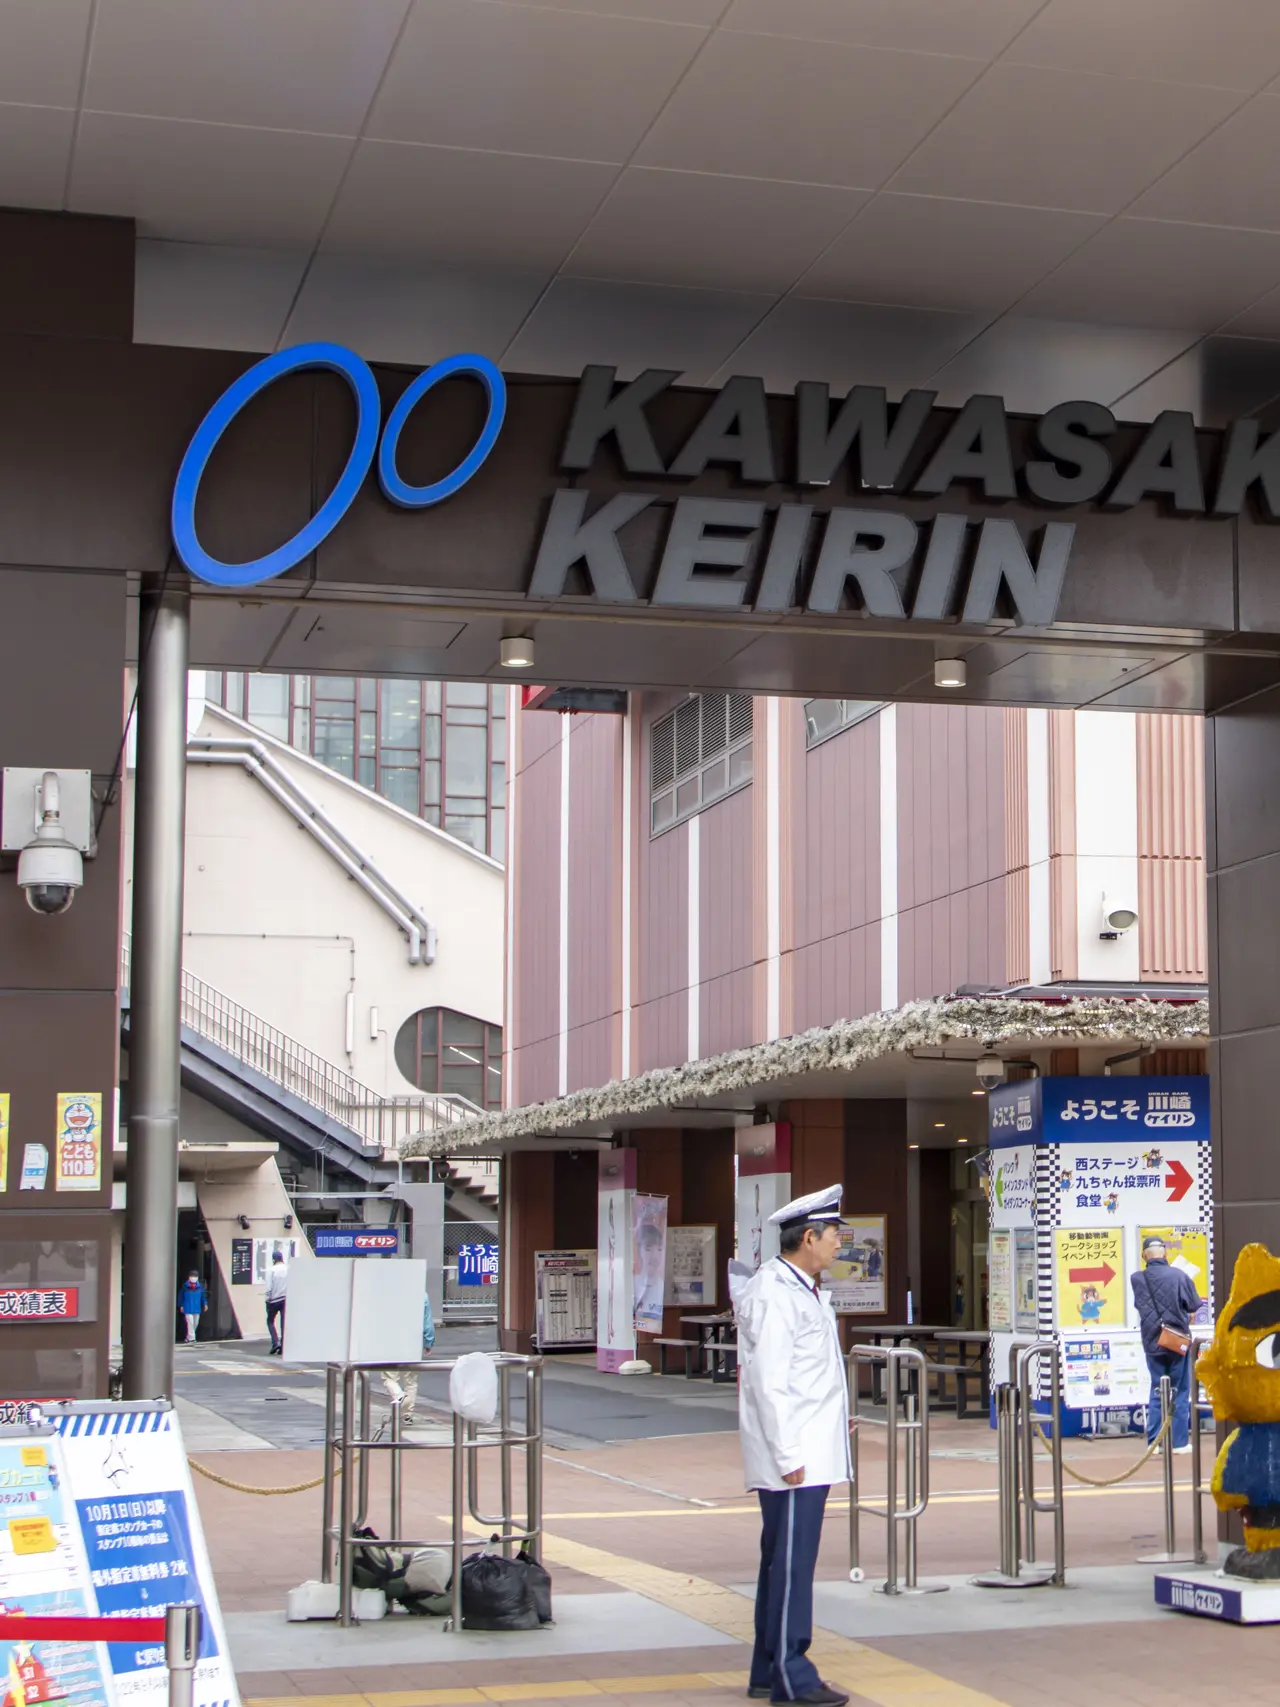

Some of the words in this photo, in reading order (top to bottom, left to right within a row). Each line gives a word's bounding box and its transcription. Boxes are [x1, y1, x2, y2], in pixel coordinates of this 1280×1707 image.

[525, 488, 1076, 628] KEIRIN
[992, 1104, 1016, 1128] ようこそ
[1060, 1099, 1141, 1121] ようこそ
[1148, 1096, 1192, 1110] 川崎
[1146, 1113, 1194, 1125] ケイリン
[63, 1144, 95, 1159] こども
[62, 1160, 95, 1176] 110番
[1075, 1156, 1139, 1170] 西ステージ
[1075, 1174, 1161, 1189] 九ちゃん投票所
[1076, 1194, 1102, 1208] 食堂
[356, 1237, 396, 1247] ケイリン
[1061, 1240, 1117, 1251] ワークショップ
[1061, 1251, 1118, 1261] イベントブース
[463, 1256, 498, 1274] 川崎
[0, 1291, 66, 1315] 成績表
